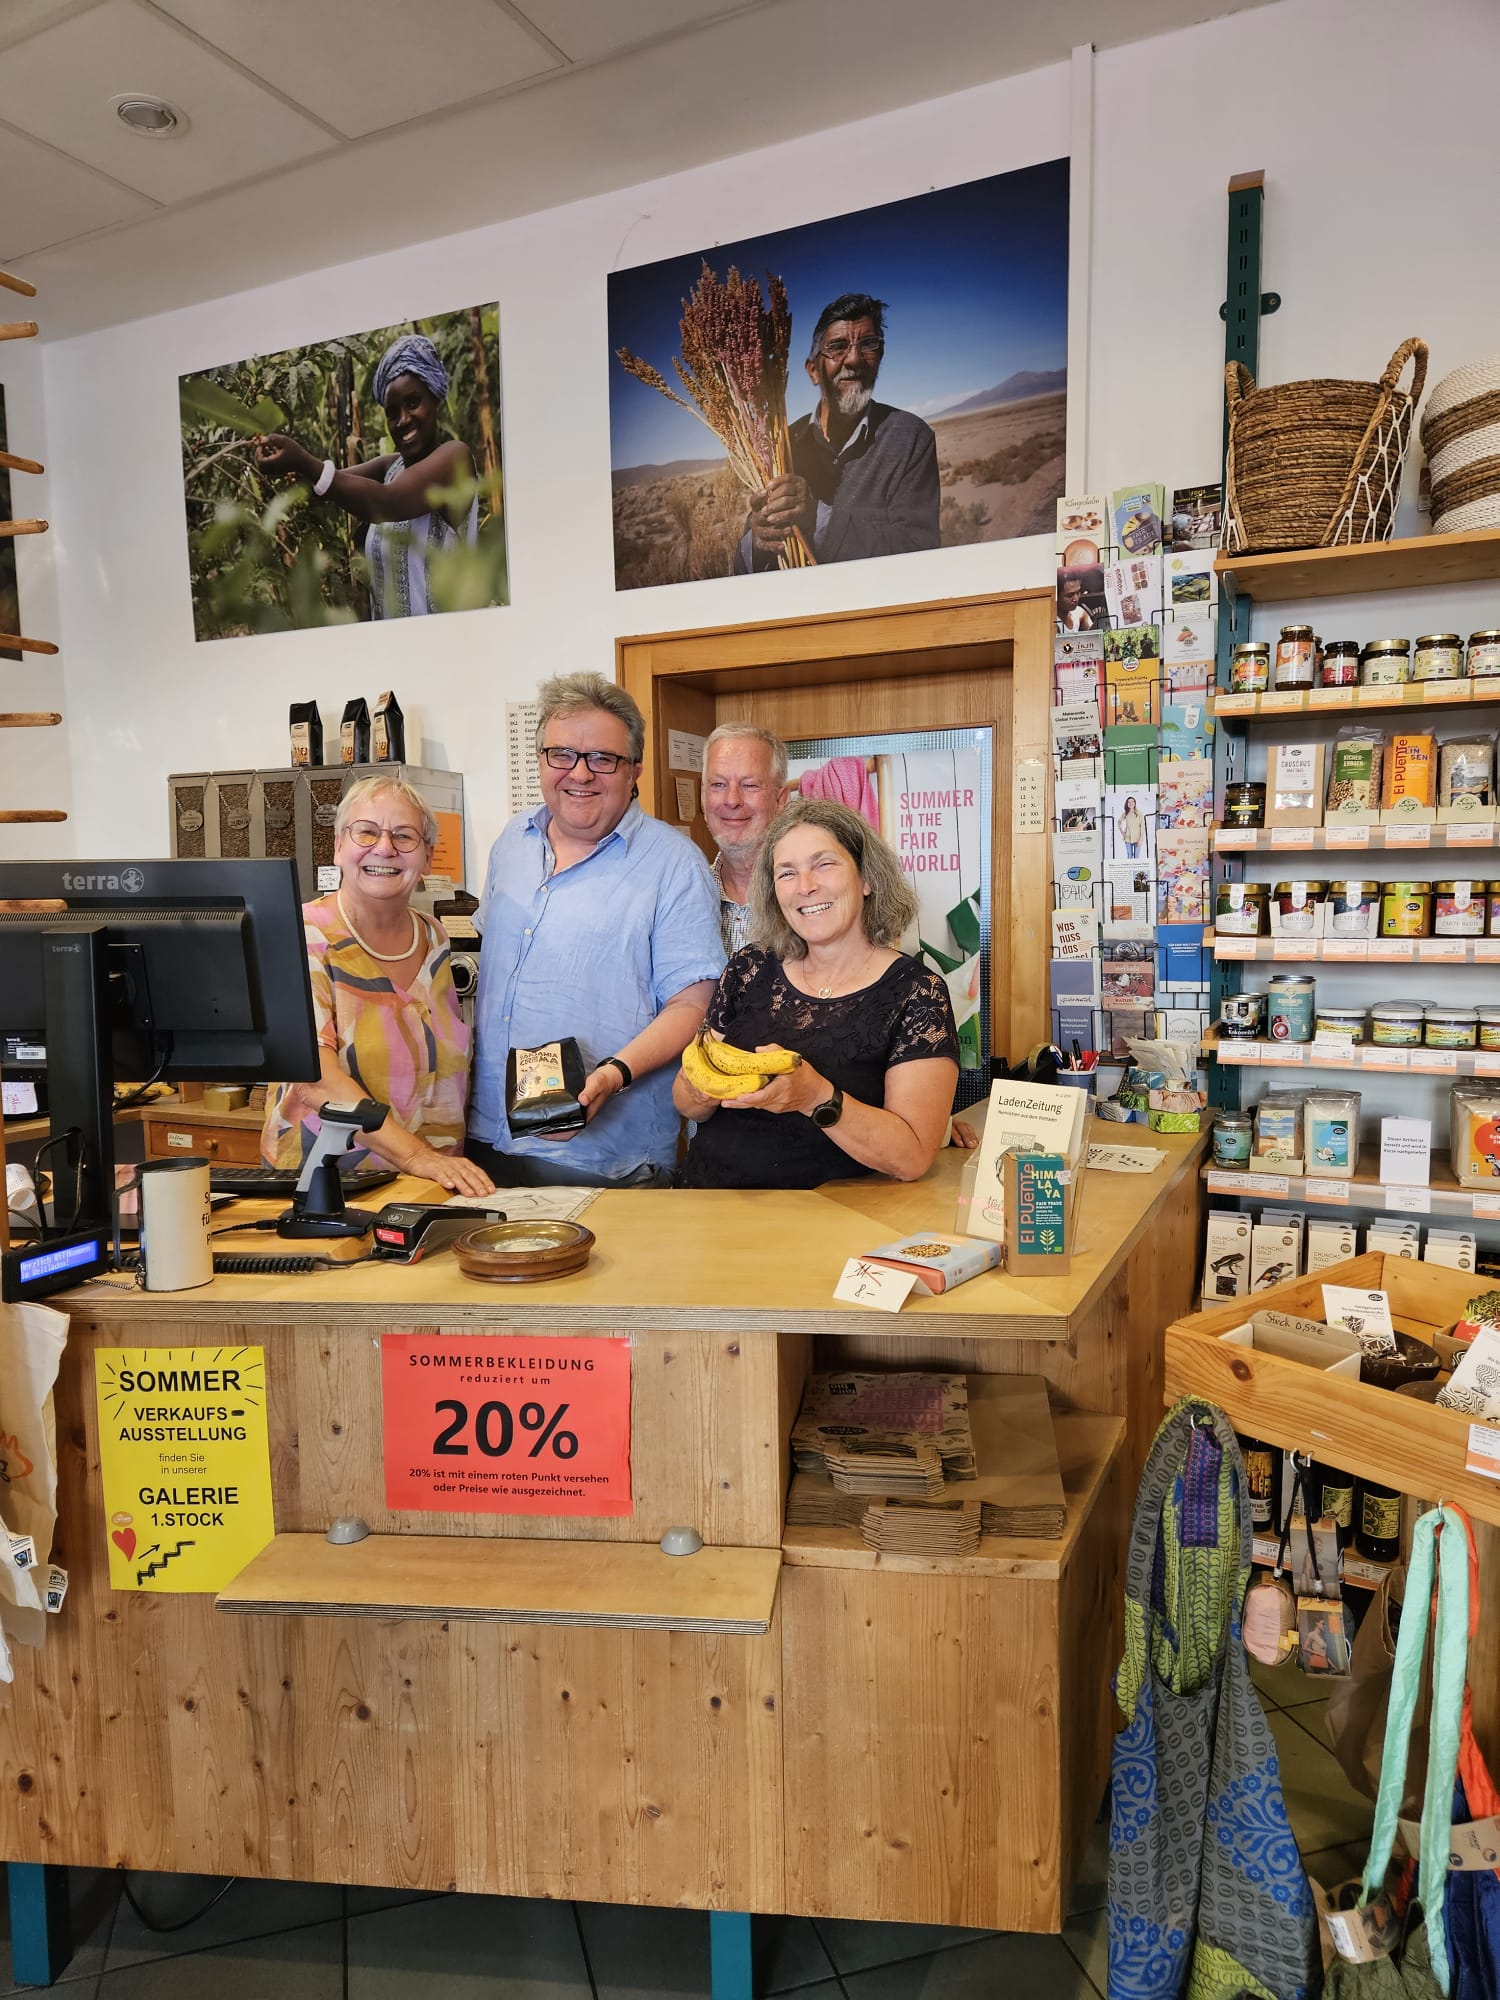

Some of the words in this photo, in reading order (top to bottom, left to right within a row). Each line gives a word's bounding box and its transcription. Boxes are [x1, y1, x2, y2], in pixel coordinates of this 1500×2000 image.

[1281, 760, 1312, 768] COUSCOUS
[900, 789, 974, 810] SUMMER
[900, 814, 913, 828] IN
[918, 812, 942, 827] THE
[900, 832, 938, 850] FAIR
[899, 854, 960, 872] WORLD
[62, 872, 119, 890] terra
[1060, 932, 1081, 943] nuss
[52, 944, 73, 952] terra
[1062, 944, 1079, 954] das
[998, 1095, 1063, 1116] LadenZeitung
[1037, 1180, 1053, 1189] LA
[1045, 1189, 1061, 1198] YA
[409, 1354, 595, 1371] SOMMERBEKLEIDUNG
[119, 1370, 242, 1392] SOMMER
[460, 1374, 525, 1384] reduziert
[531, 1376, 551, 1385] um
[119, 1427, 247, 1441] AUSSTELLUNG
[432, 1399, 579, 1459] 20%
[159, 1453, 187, 1462] finden
[189, 1453, 205, 1462] Sie
[161, 1465, 170, 1474] in
[172, 1466, 207, 1475] unserer
[409, 1468, 431, 1478] 20%
[433, 1469, 446, 1478] ist
[448, 1469, 465, 1479] mit
[467, 1471, 498, 1480] einem
[501, 1472, 528, 1481] roten
[531, 1473, 561, 1482] Punkt
[563, 1474, 609, 1483] versehen
[138, 1487, 239, 1505] GALERIE
[433, 1484, 456, 1492] oder
[458, 1484, 489, 1494] Preise
[491, 1485, 509, 1495] wie
[511, 1486, 586, 1498] ausgezeichnet.
[151, 1512, 225, 1527] 1.STOCK
